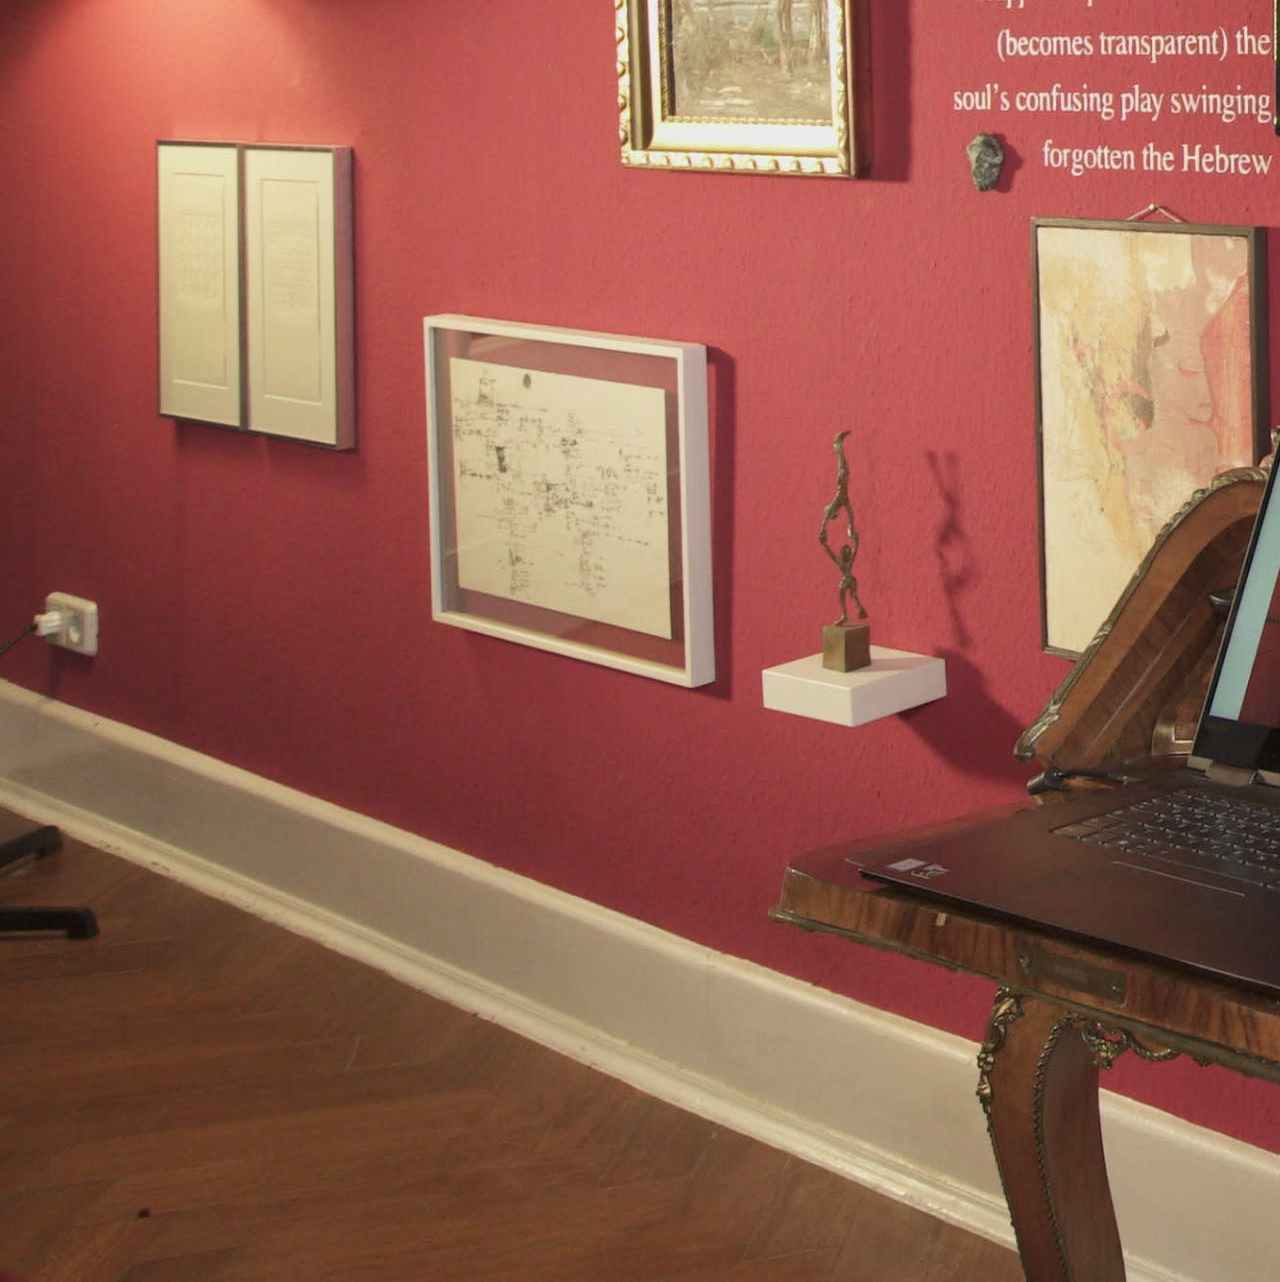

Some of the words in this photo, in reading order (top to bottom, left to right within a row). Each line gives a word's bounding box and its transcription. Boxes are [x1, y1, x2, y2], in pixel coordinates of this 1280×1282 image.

[997, 29, 1093, 61] (becomes
[1099, 27, 1228, 63] transparent)
[1235, 26, 1271, 55] the
[954, 83, 1010, 110] soul's
[1015, 83, 1114, 120] confusing
[1121, 84, 1164, 121] play
[1171, 84, 1272, 123] swinging
[1042, 139, 1135, 176] forgotten
[1142, 142, 1175, 172] the
[1182, 144, 1272, 174] Hebrew
